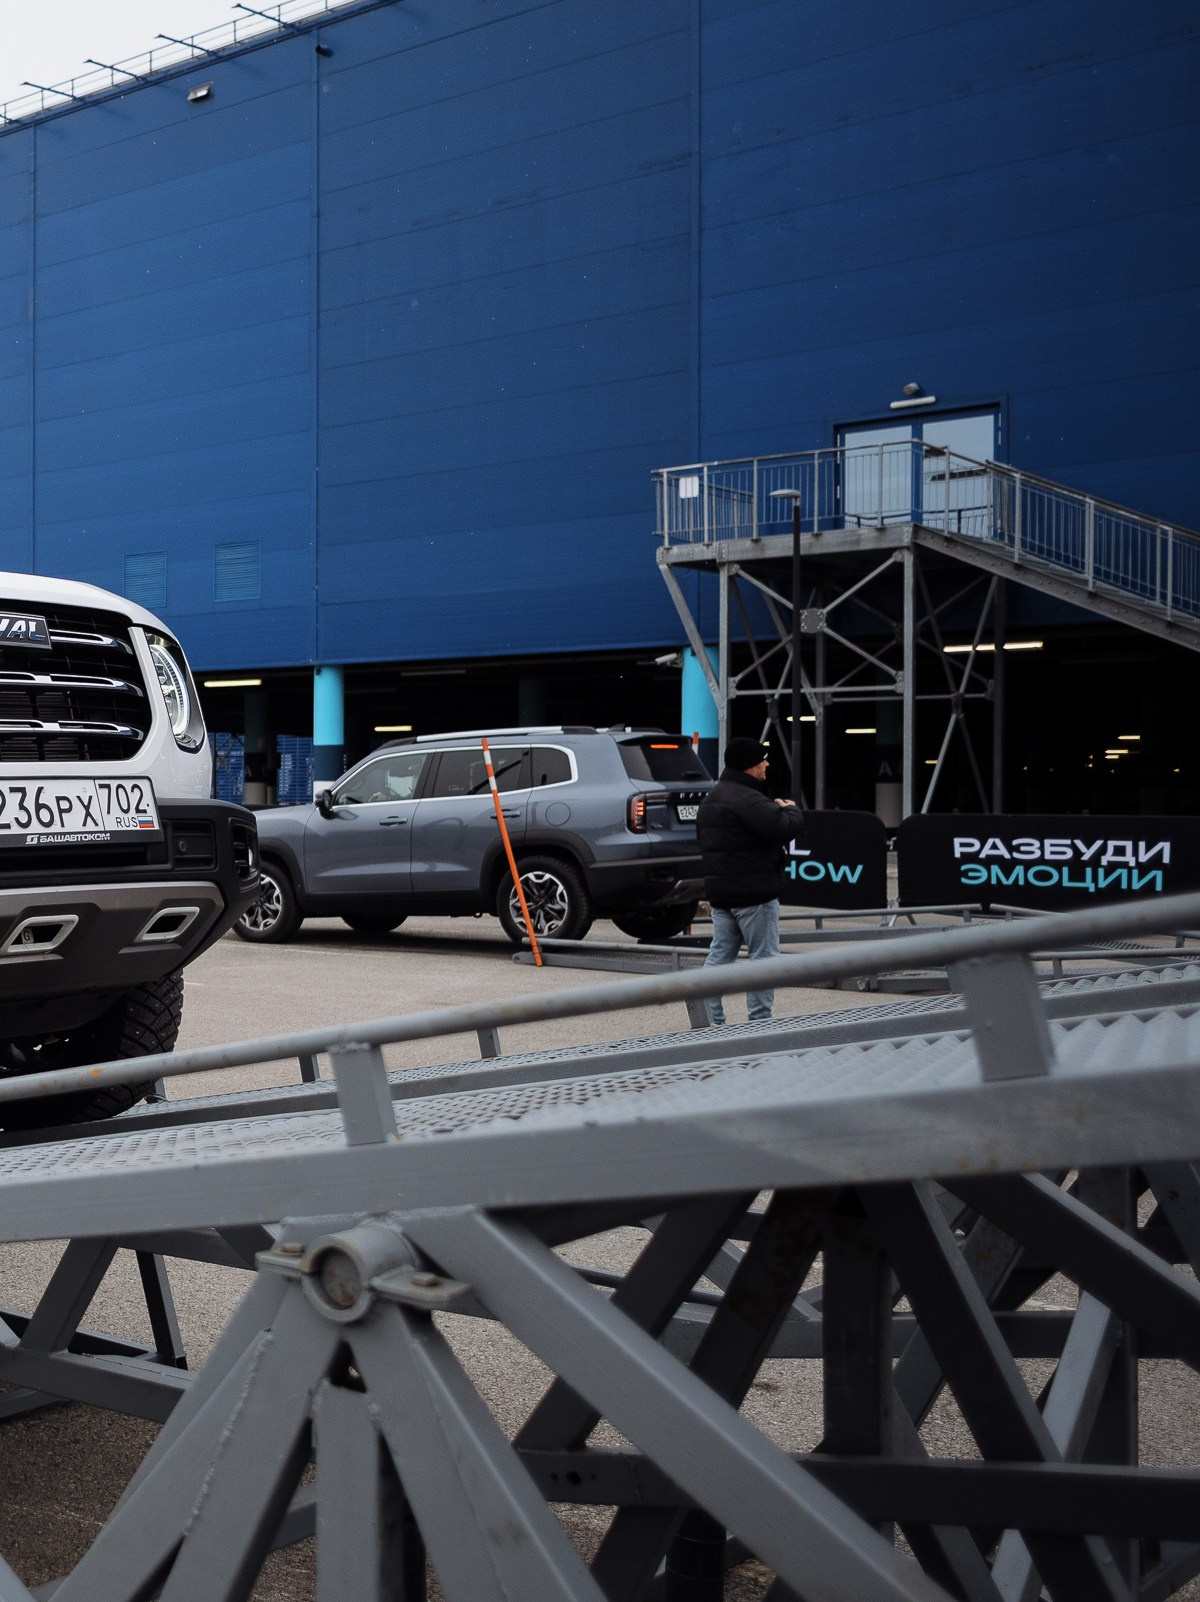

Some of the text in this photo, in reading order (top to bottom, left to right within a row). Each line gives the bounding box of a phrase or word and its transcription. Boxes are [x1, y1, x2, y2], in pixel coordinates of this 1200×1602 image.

[98, 784, 148, 815] 702
[115, 816, 138, 828] RUS
[40, 833, 111, 843] БАШАВТОКОМ
[782, 839, 811, 856] L
[953, 837, 1171, 867] РАЗБУДИ
[960, 864, 1164, 893] ЭМОЦИИ
